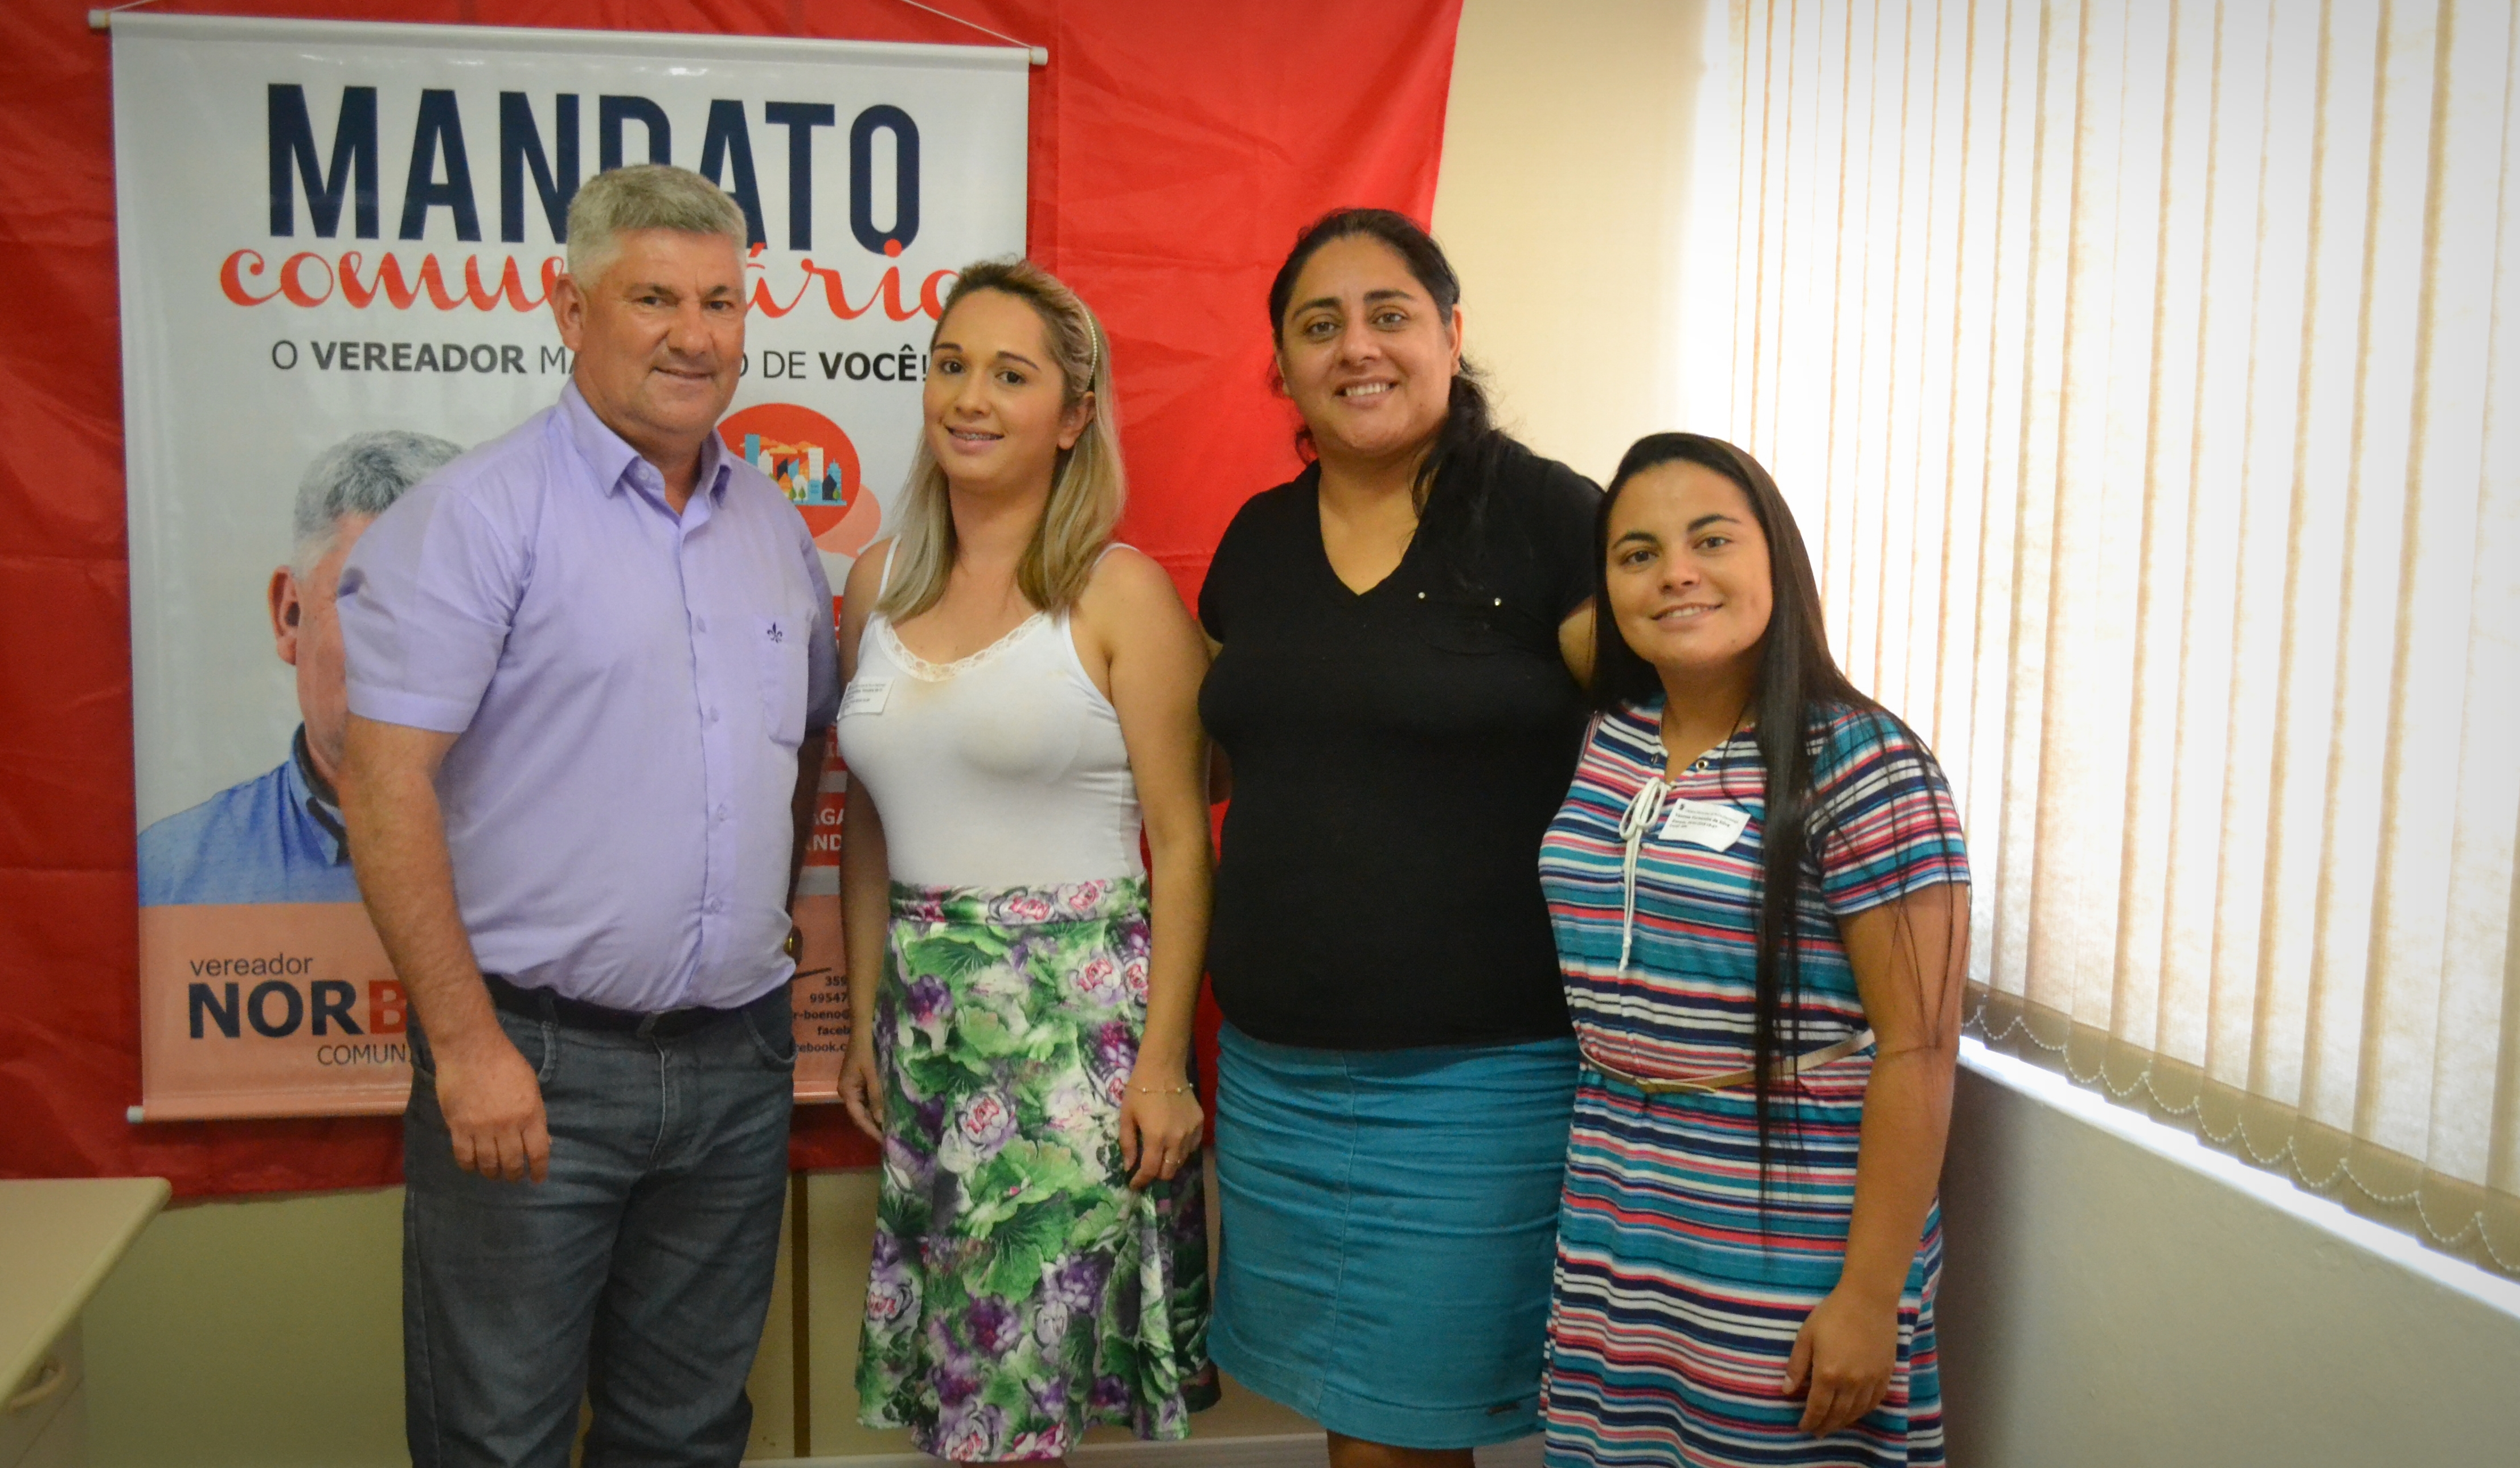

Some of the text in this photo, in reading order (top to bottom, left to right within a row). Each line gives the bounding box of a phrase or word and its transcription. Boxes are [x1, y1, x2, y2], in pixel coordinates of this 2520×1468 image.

[272, 340, 298, 370] O
[311, 341, 527, 374] VEREADOR
[540, 345, 575, 375] M
[764, 350, 806, 380] DE
[818, 344, 927, 382] VOCÊ!
[190, 953, 313, 977] vereador
[189, 979, 408, 1039] NORB
[317, 1043, 409, 1065] COMUN
